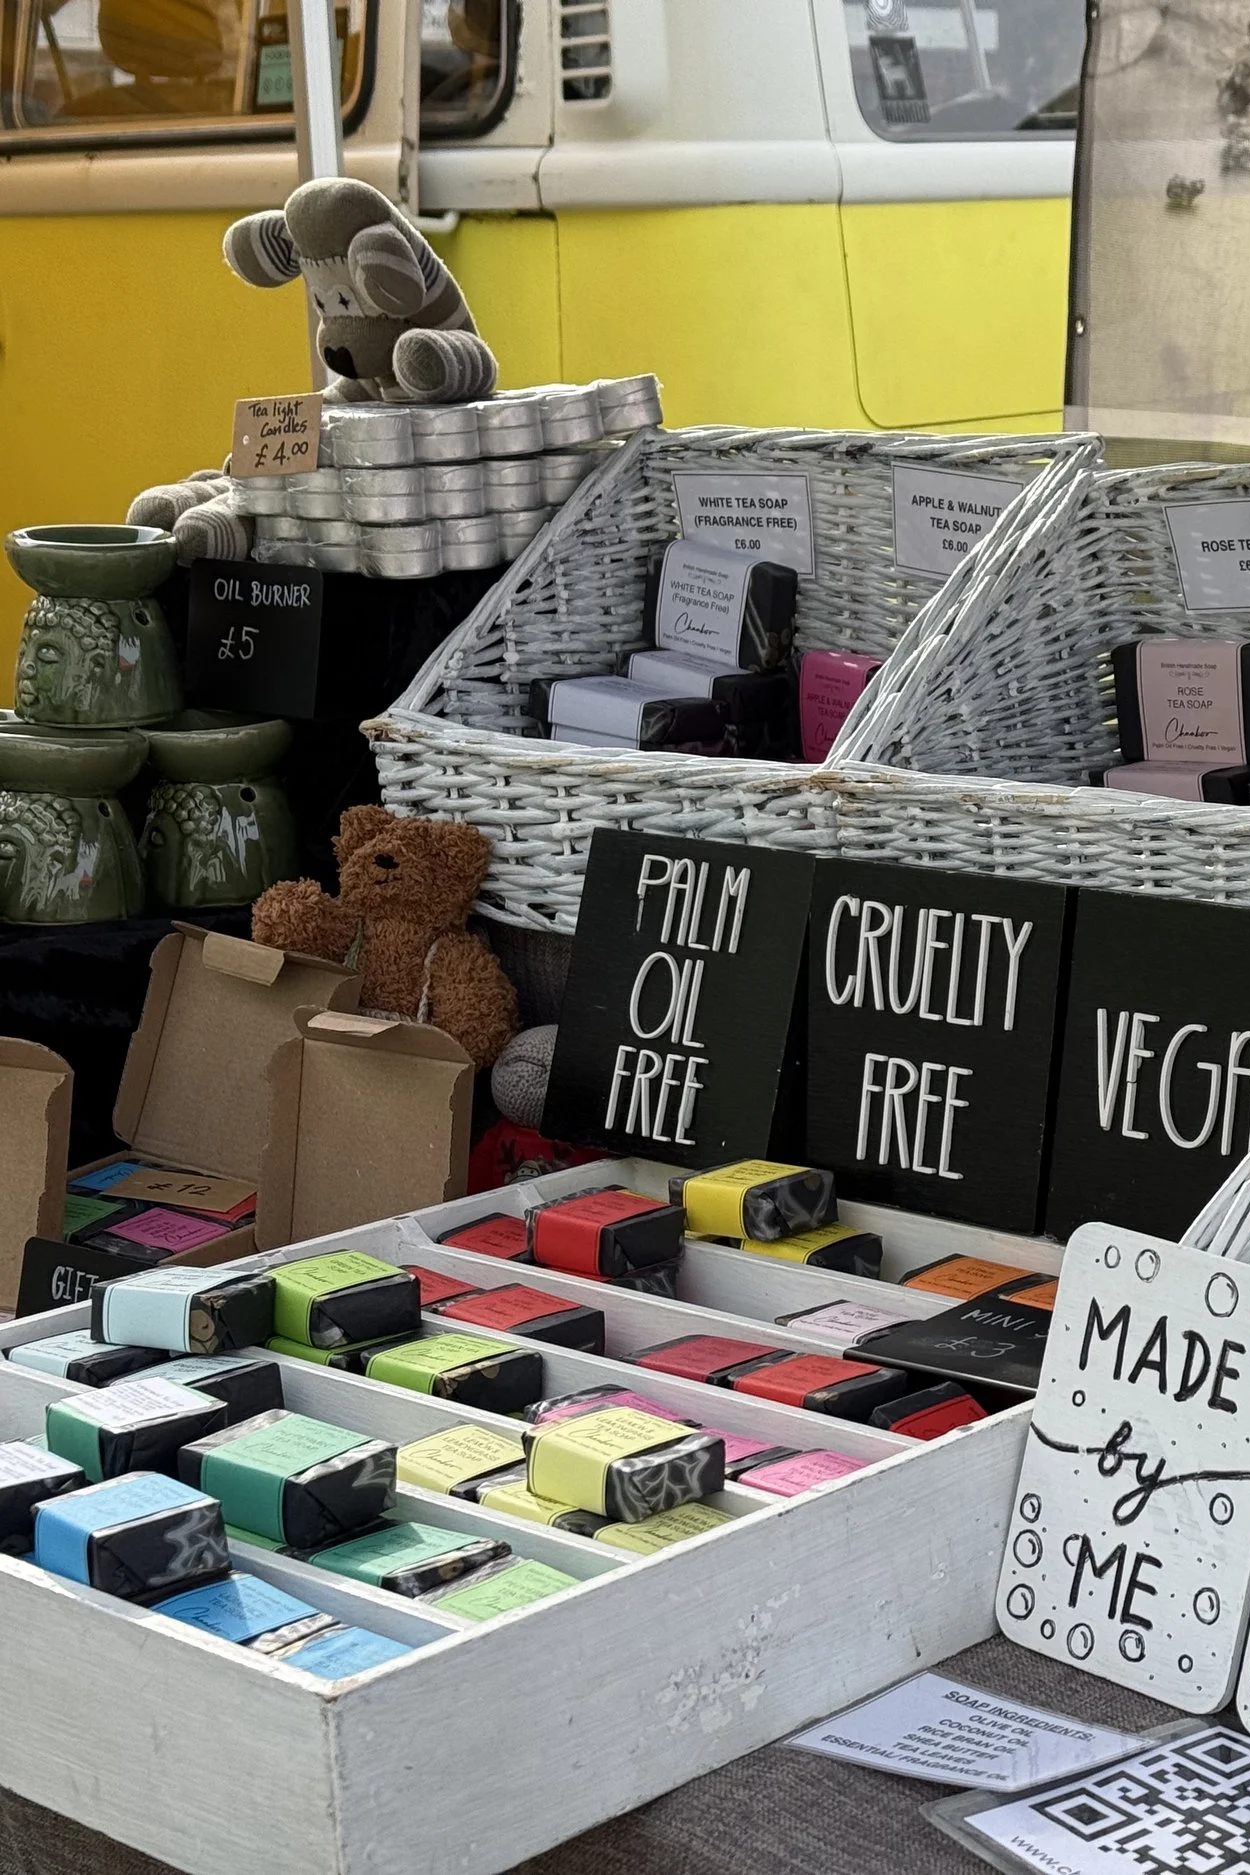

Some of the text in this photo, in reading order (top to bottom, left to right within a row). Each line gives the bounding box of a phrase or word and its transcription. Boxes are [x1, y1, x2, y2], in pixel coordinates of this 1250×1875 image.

[248, 401, 303, 423] Tea light
[260, 417, 307, 437] Candles
[698, 497, 788, 509] WHITE TEA SOAP
[911, 494, 1002, 518] APPLE & WALNUT
[695, 515, 797, 530] (FRAGRANCE FREE)
[930, 517, 982, 534] TEA SOAP
[735, 539, 760, 550] £6.00
[942, 538, 968, 553] £6.00
[1201, 540, 1235, 552] ROSE
[214, 578, 311, 608] OIL BURNER
[671, 580, 735, 602] WHITE TEA SOAP
[672, 594, 730, 614] (Fragrance Free)
[218, 626, 259, 660] £5
[1177, 687, 1204, 696] ROSE
[1168, 700, 1213, 709] TEA SOAP
[636, 854, 751, 954] PALM
[825, 894, 1034, 1031] CRUELTY
[630, 951, 705, 1048] OIL
[604, 1044, 709, 1145] FREE
[856, 1052, 974, 1180] FREE
[52, 1266, 99, 1303] GIFT
[961, 1309, 1036, 1331] MINI
[1078, 1296, 1248, 1414] MADE
[1067, 1534, 1163, 1630] ME
[941, 1690, 1096, 1742] SOAP INGREDIENTS:
[969, 1714, 1032, 1737] OLIVE OIL
[918, 1725, 1014, 1754] RICE BRAN OIL
[939, 1719, 1030, 1747] COCONUT OIL
[893, 1741, 976, 1765] TEA LEAVES
[903, 1733, 999, 1761] SHEA BUTTER
[898, 1754, 984, 1778] FRAGRANCE
[1011, 1836, 1081, 1875] www.c
